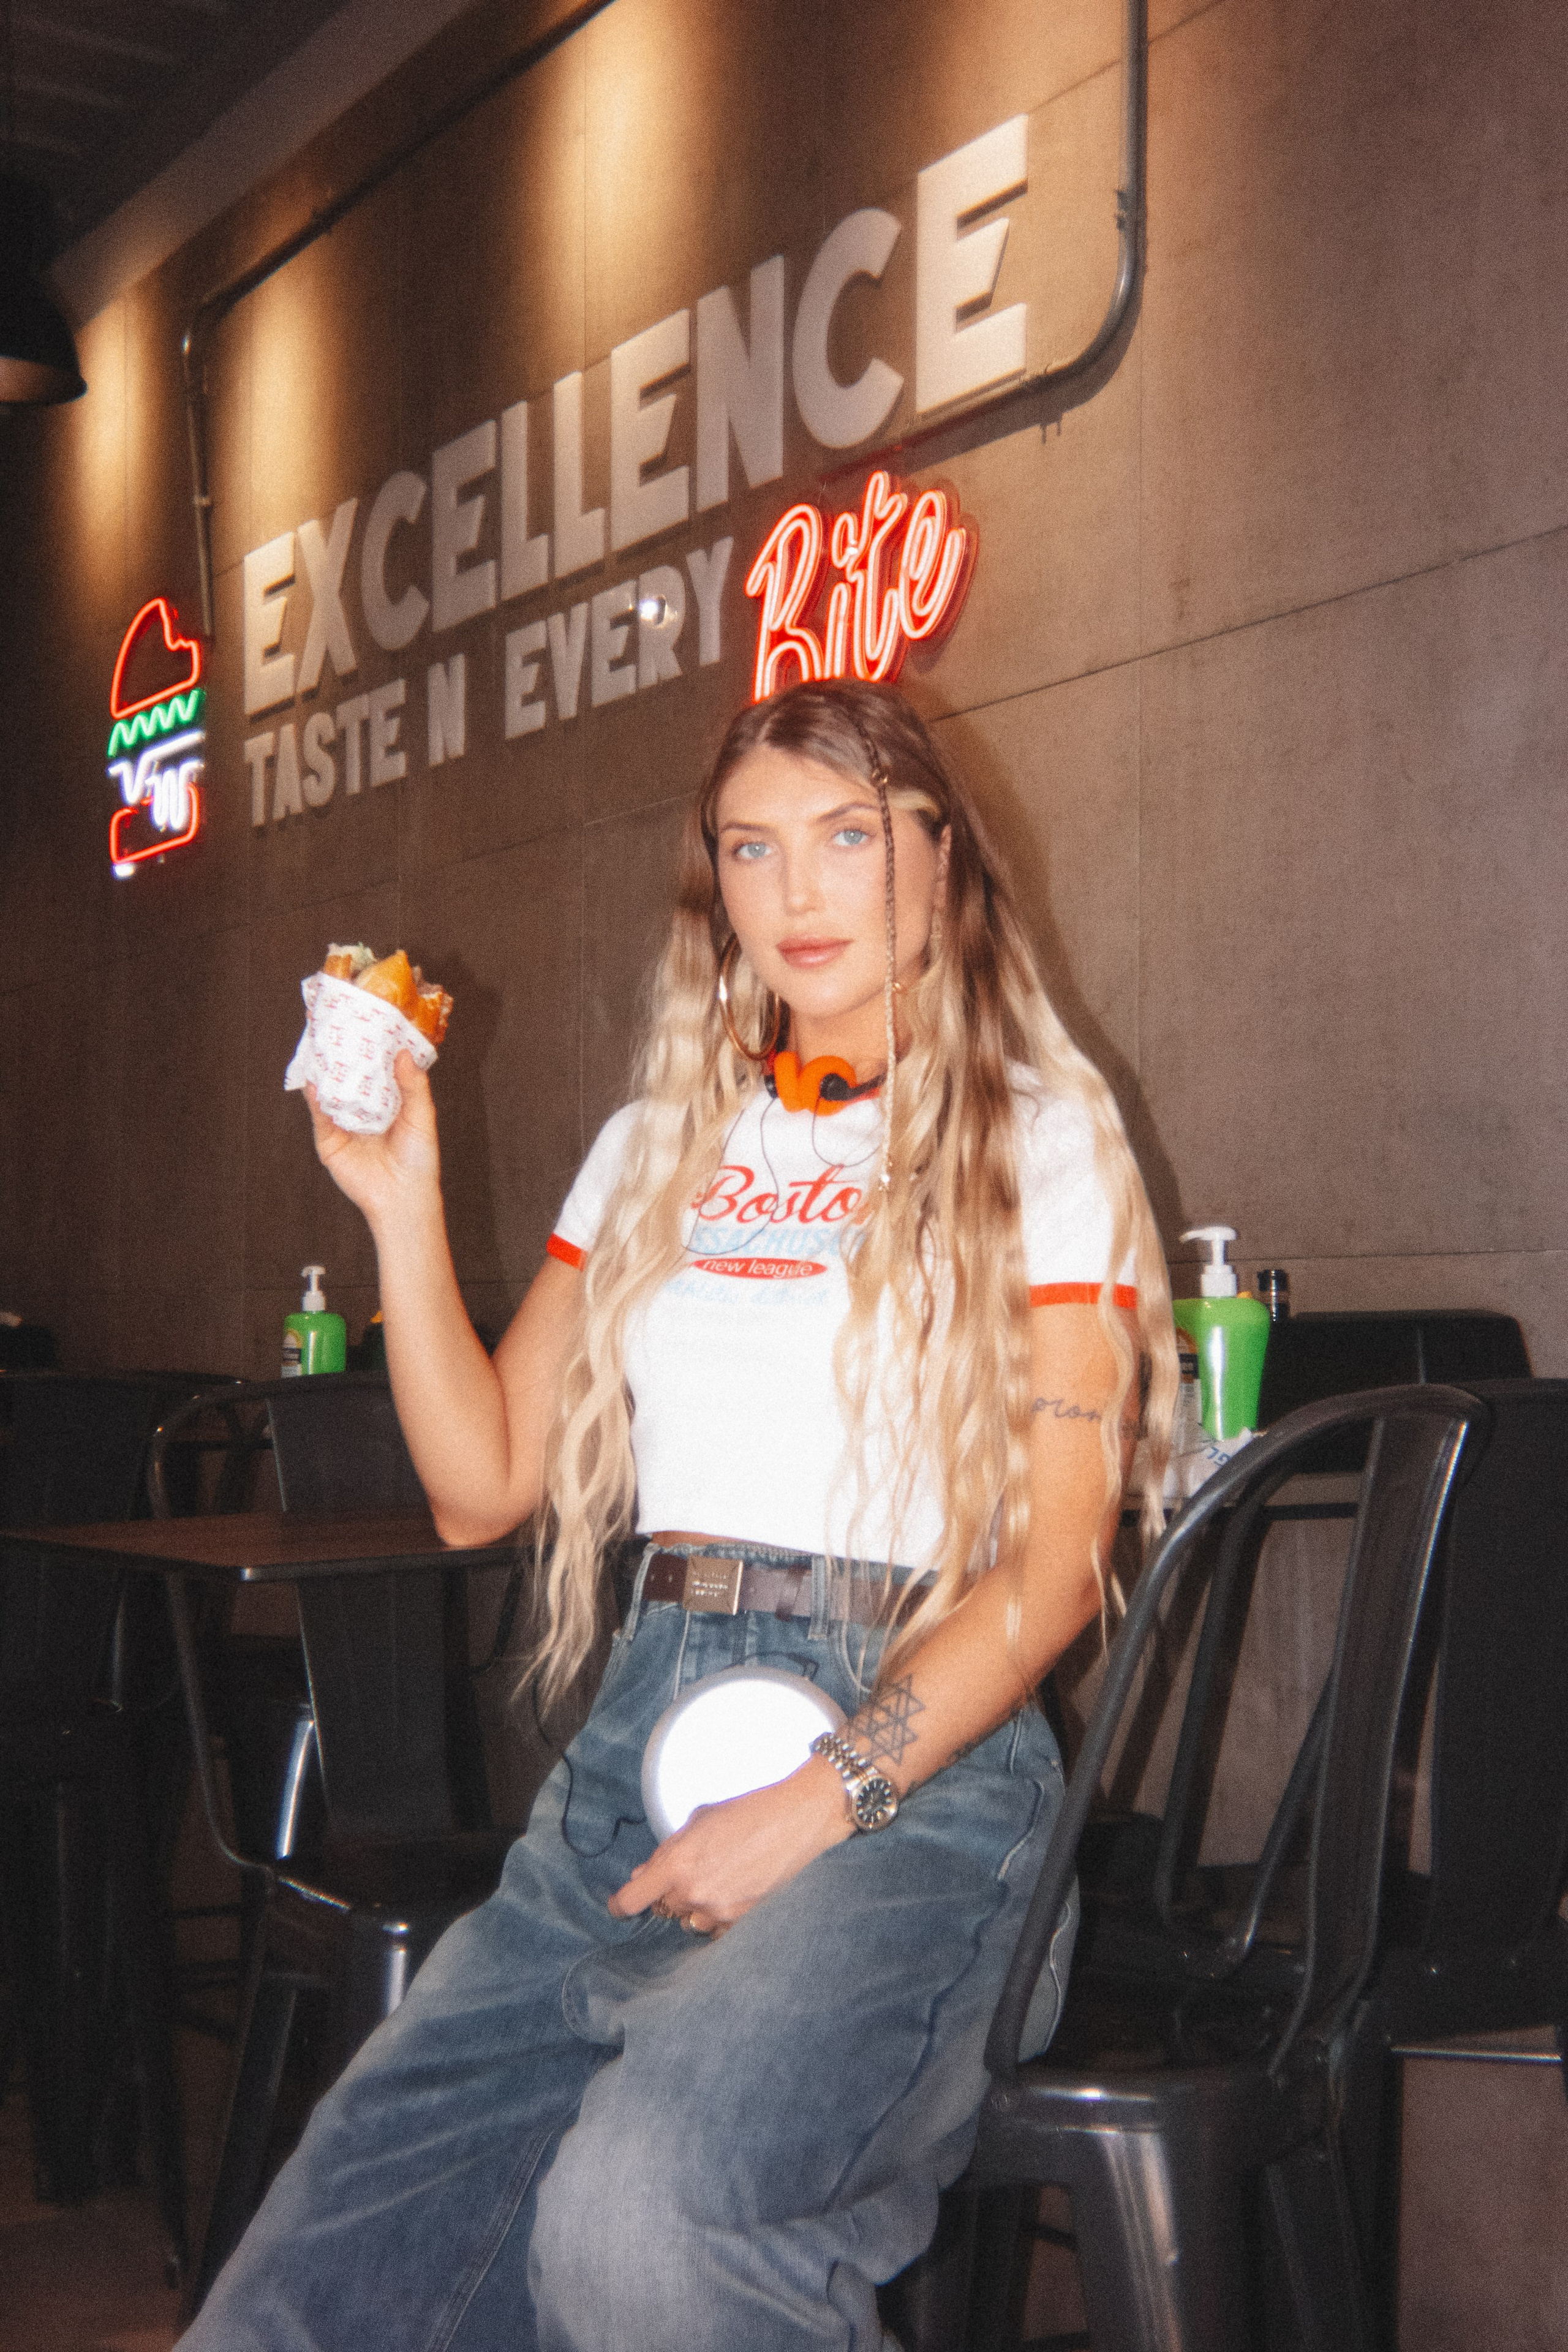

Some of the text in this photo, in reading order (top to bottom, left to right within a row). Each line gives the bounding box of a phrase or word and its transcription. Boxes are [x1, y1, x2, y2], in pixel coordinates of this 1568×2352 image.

[244, 113, 1029, 717] EXCELLENCE
[244, 678, 407, 827] TASTE
[505, 536, 734, 741] EVERY
[745, 470, 966, 704] Bite
[691, 1163, 872, 1225] Bosto
[703, 1259, 813, 1279] new league
